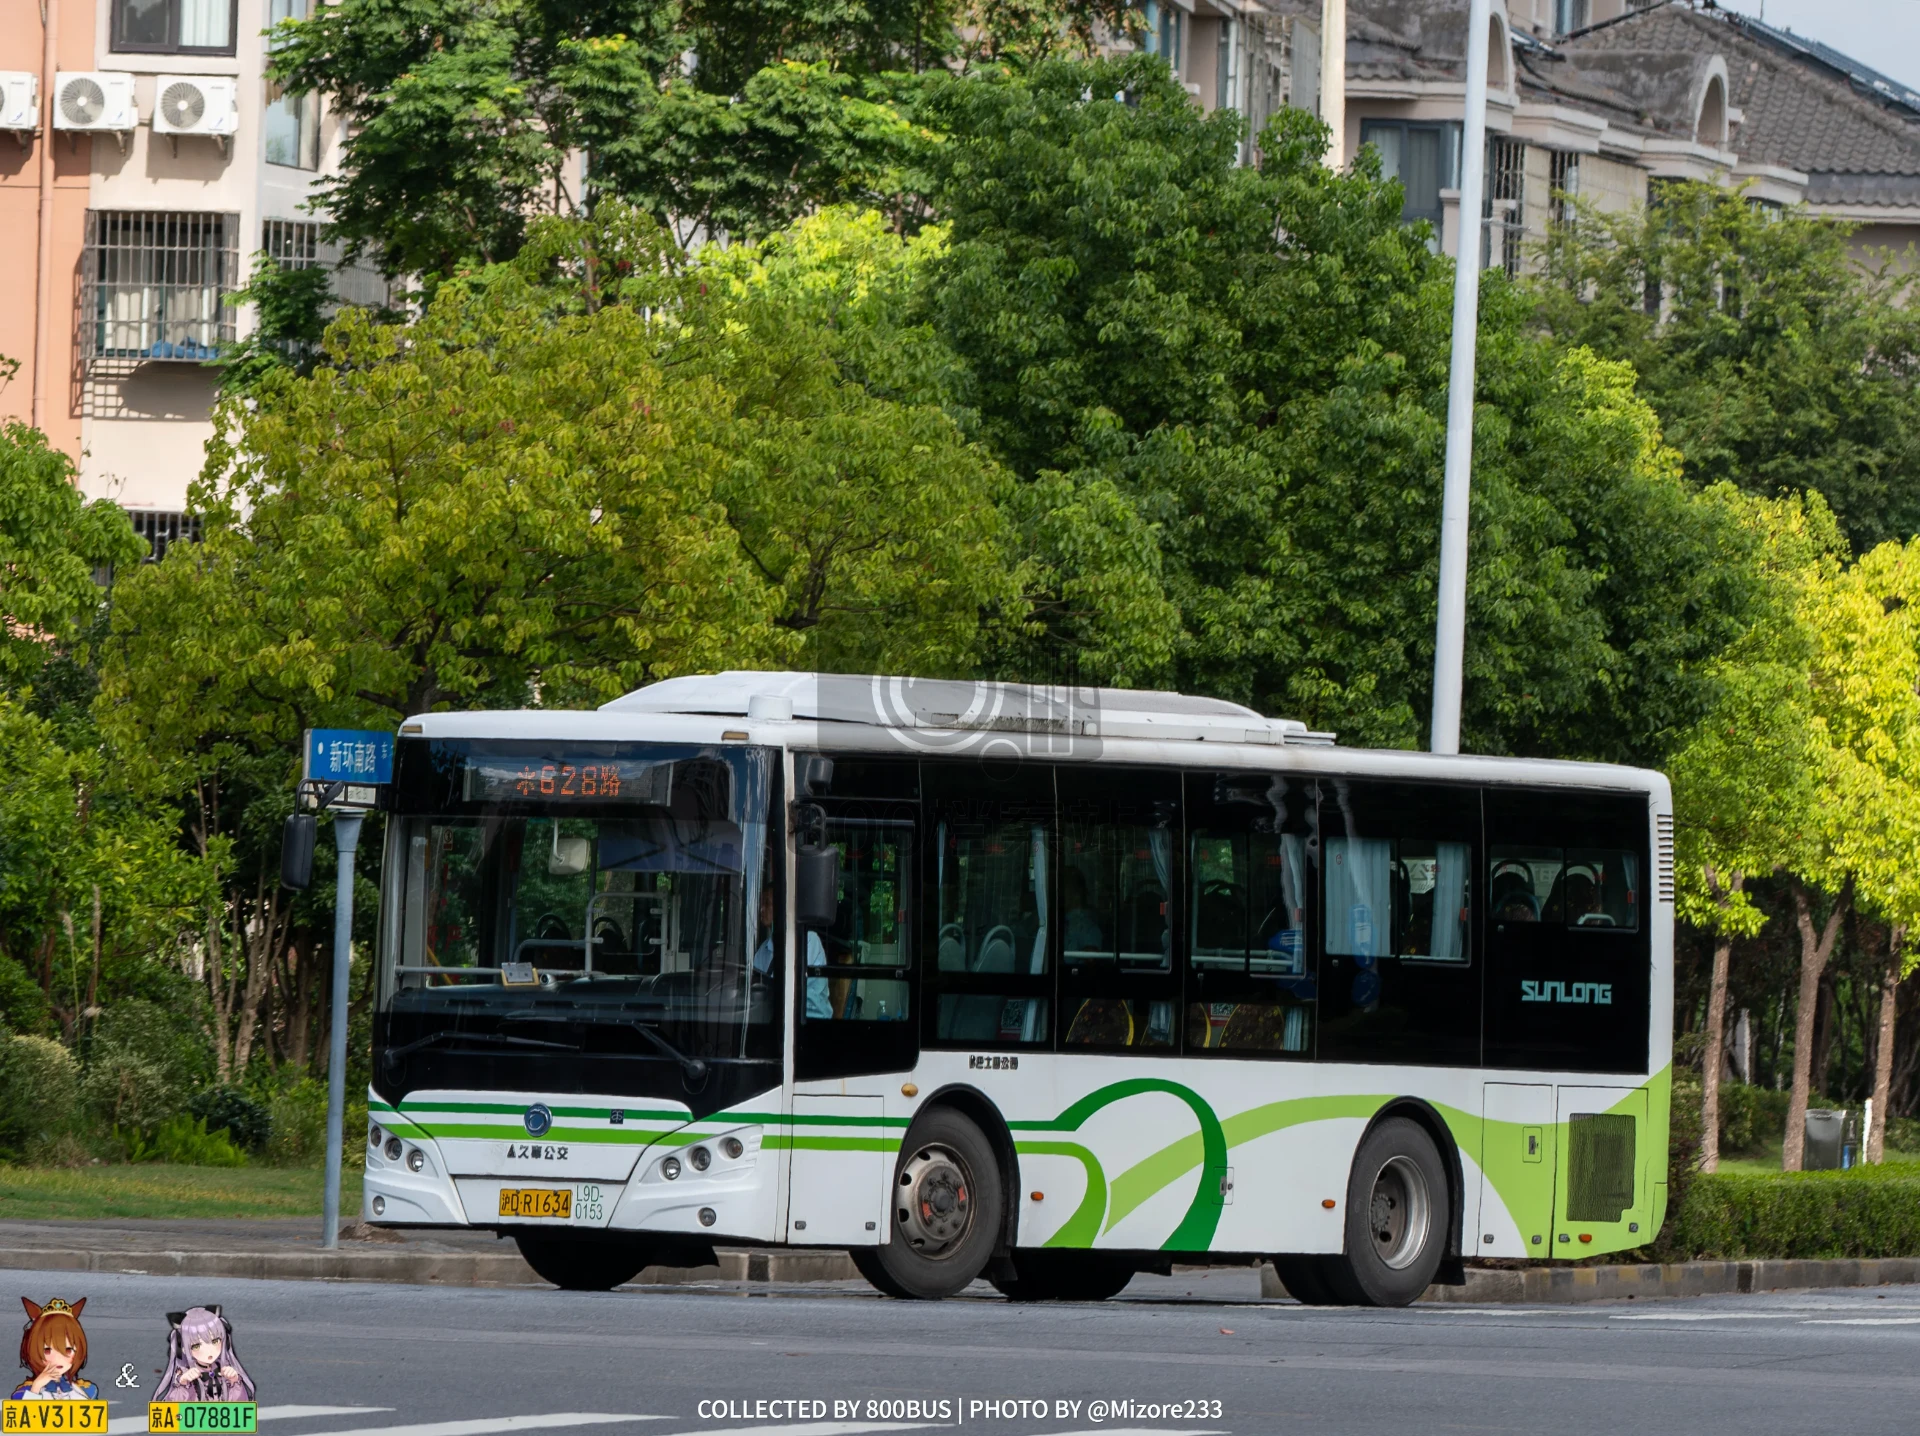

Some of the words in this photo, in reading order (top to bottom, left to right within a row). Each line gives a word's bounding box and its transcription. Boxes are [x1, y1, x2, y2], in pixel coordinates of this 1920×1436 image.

[330, 740, 376, 773] 新环南路
[1522, 980, 1612, 1005] SUNLONG
[576, 1185, 604, 1202] L9D-
[575, 1203, 603, 1220] 0153
